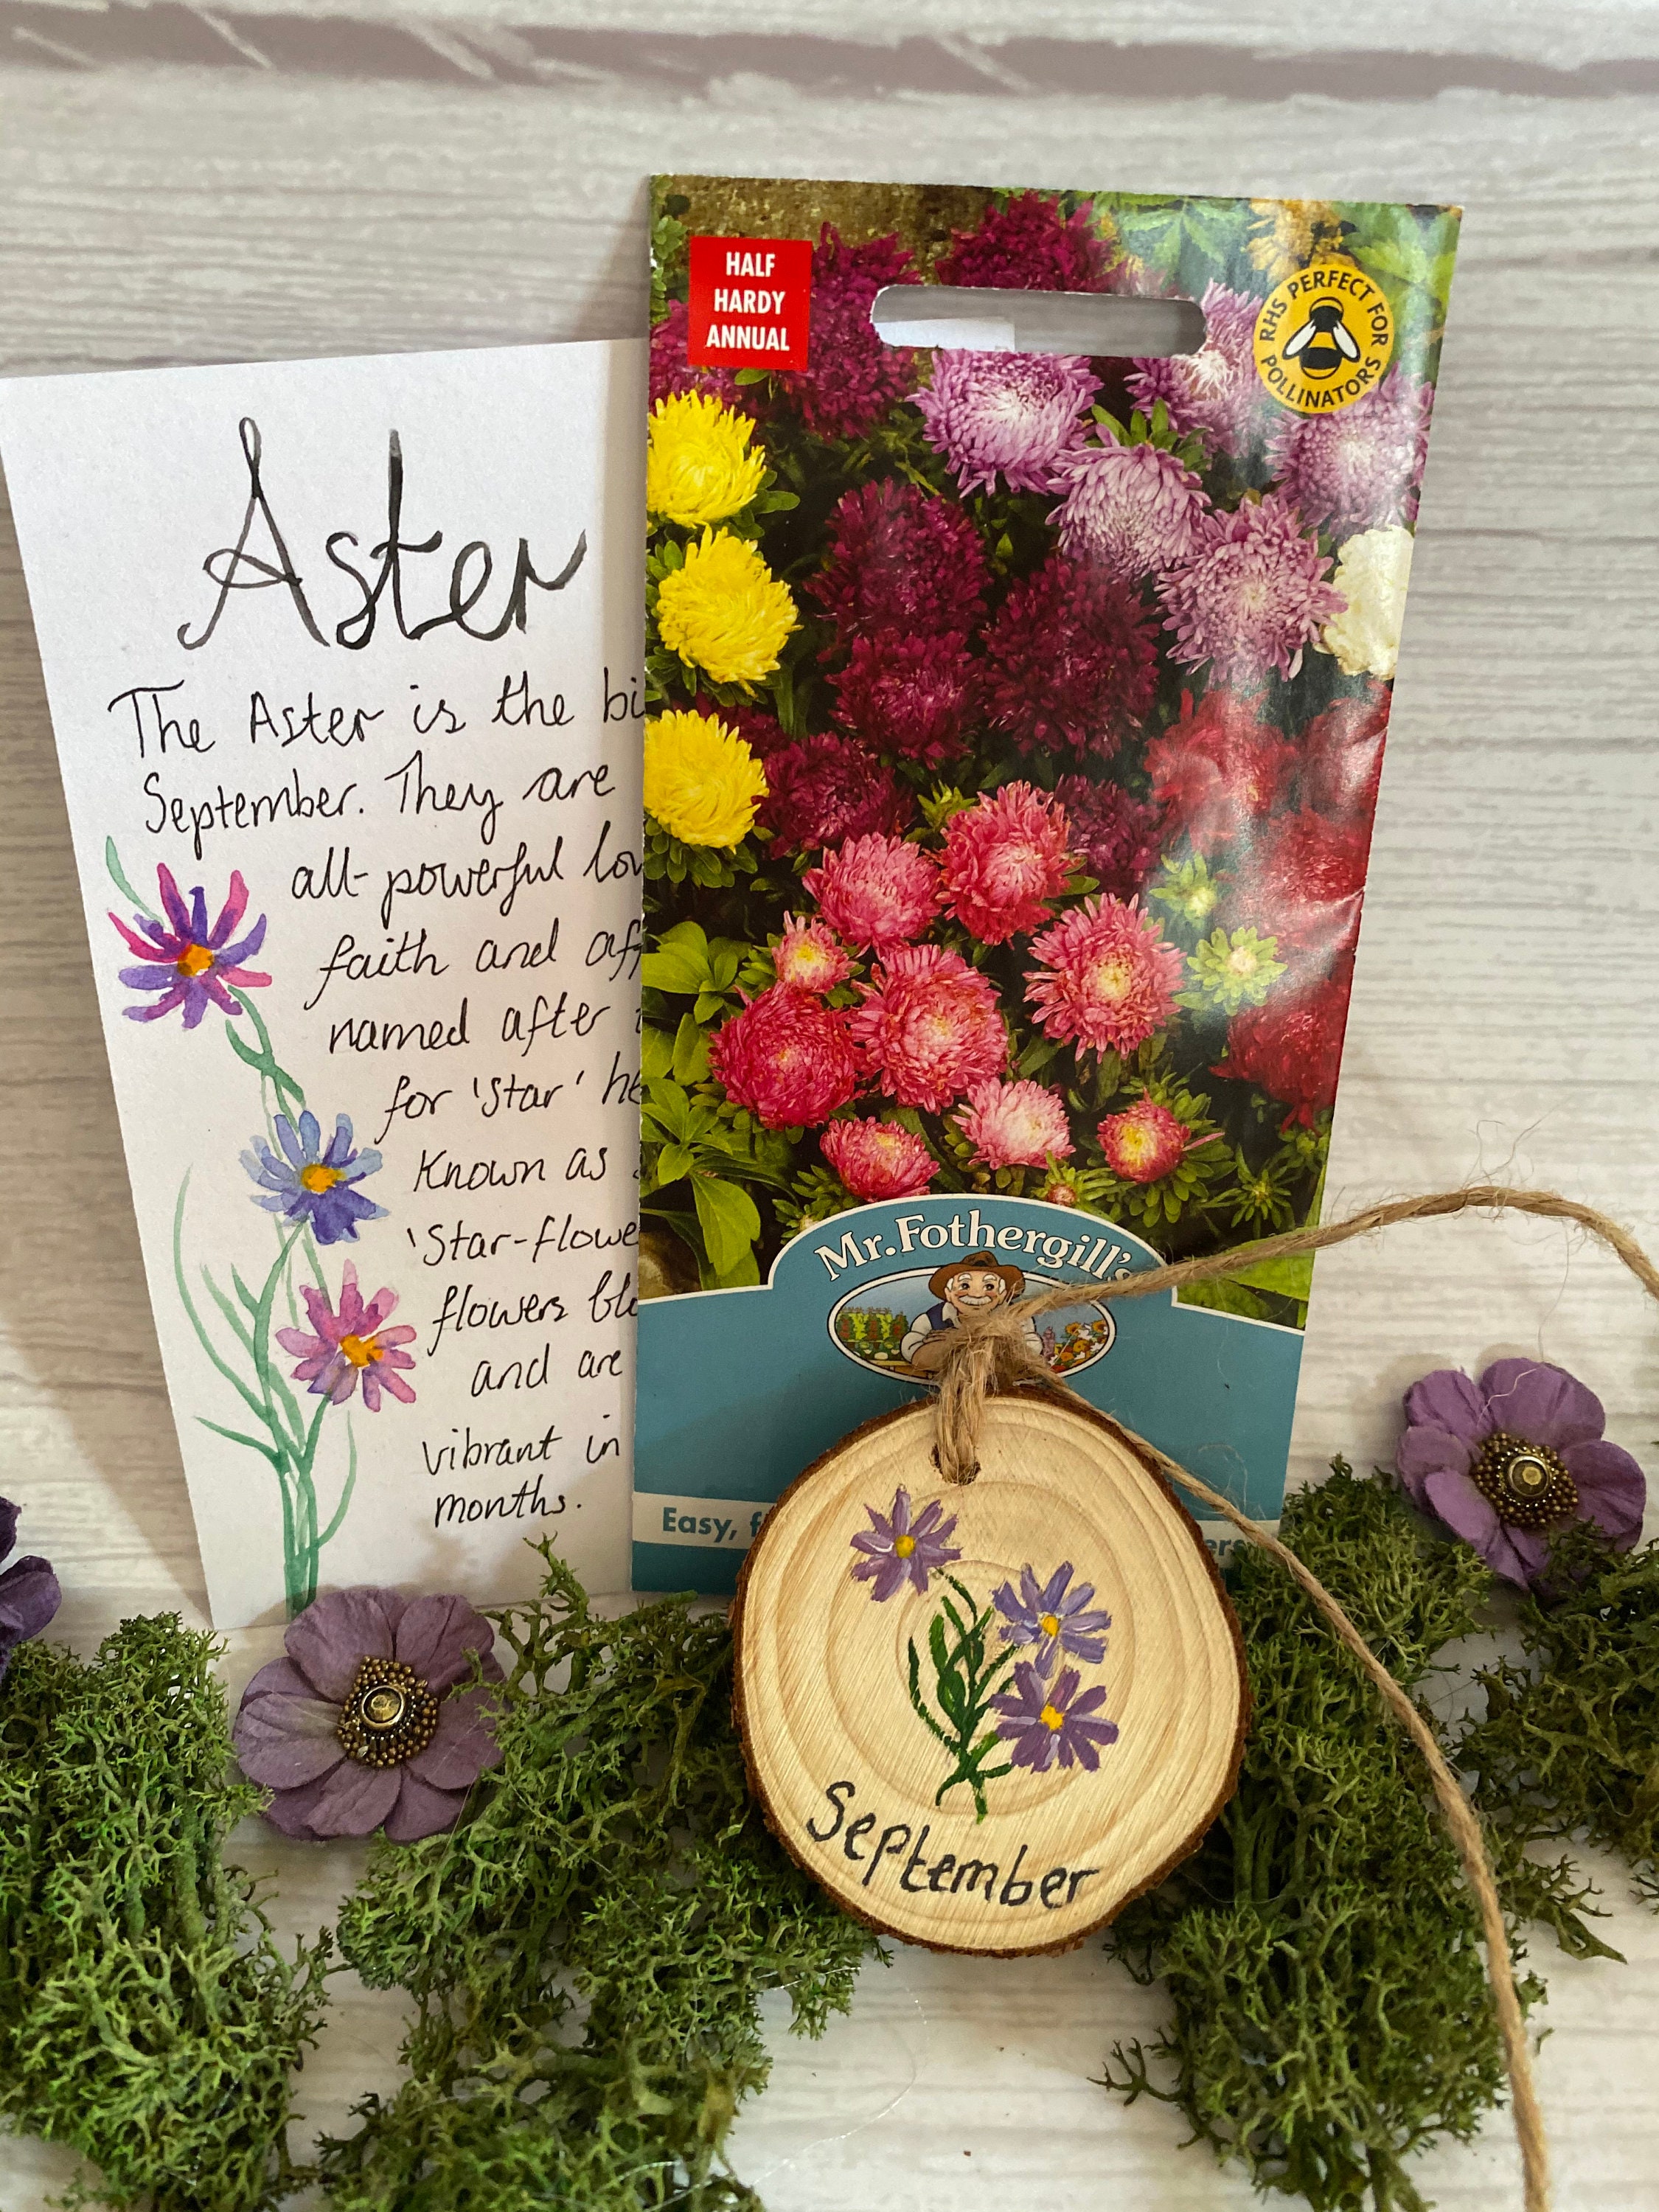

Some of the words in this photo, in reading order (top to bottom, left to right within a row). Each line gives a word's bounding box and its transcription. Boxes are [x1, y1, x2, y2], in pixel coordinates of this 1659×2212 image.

[726, 251, 776, 278] HALF
[713, 288, 786, 315] HARDY
[1259, 298, 1287, 341] RHS
[1287, 270, 1375, 302] PERFECT
[1366, 302, 1388, 347] FOR
[706, 324, 790, 352] ANNUAL
[1261, 354, 1381, 408] POLLINATORS
[178, 417, 587, 650] Aster
[108, 680, 215, 759] The
[251, 692, 385, 747] Aster
[410, 685, 466, 734] is
[492, 671, 575, 726] the
[144, 768, 364, 860] September.
[384, 750, 504, 844] They
[523, 764, 616, 801] are
[304, 928, 449, 1010] faith
[476, 917, 560, 974] and
[329, 998, 470, 1054] named
[501, 992, 611, 1057] after
[374, 1076, 452, 1144] for
[413, 1150, 546, 1192] Known
[565, 1147, 608, 1181] as
[428, 1284, 568, 1355] flowers
[471, 1343, 550, 1398] and
[578, 1349, 623, 1379] are
[422, 1425, 563, 1475] vibrant
[587, 1414, 620, 1464] in
[434, 1475, 582, 1528] months.
[663, 1506, 737, 1543] Easy,
[806, 1781, 1099, 1909] September
